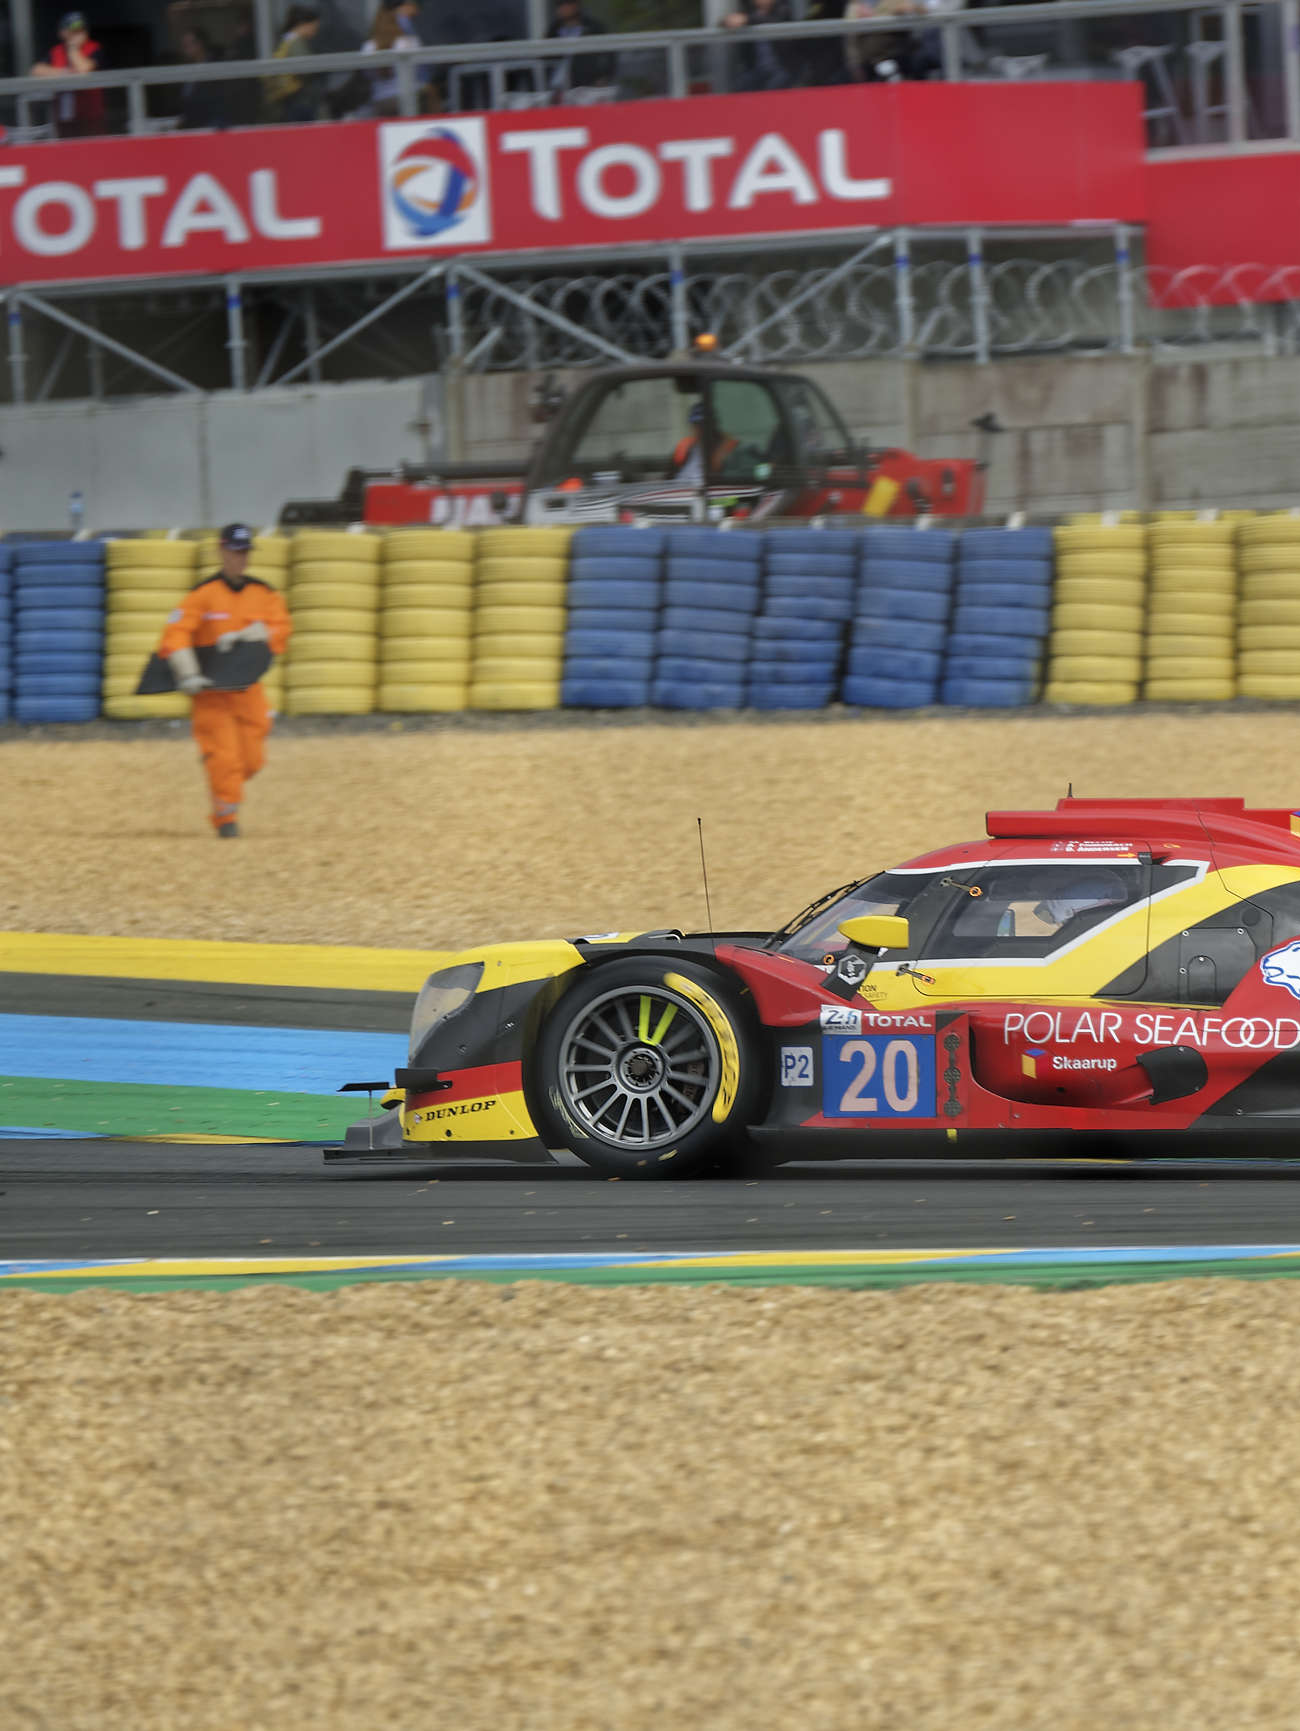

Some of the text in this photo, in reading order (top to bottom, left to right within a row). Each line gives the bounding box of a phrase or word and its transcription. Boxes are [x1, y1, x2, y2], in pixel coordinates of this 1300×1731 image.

[499, 126, 892, 221] TOTAL
[864, 1013, 932, 1028] TOTAL
[1004, 1011, 1122, 1045] POLAR
[784, 1054, 809, 1079] P2
[839, 1039, 919, 1112] 20
[1052, 1056, 1117, 1072] Skaarup
[424, 1100, 496, 1121] DUNLOP
